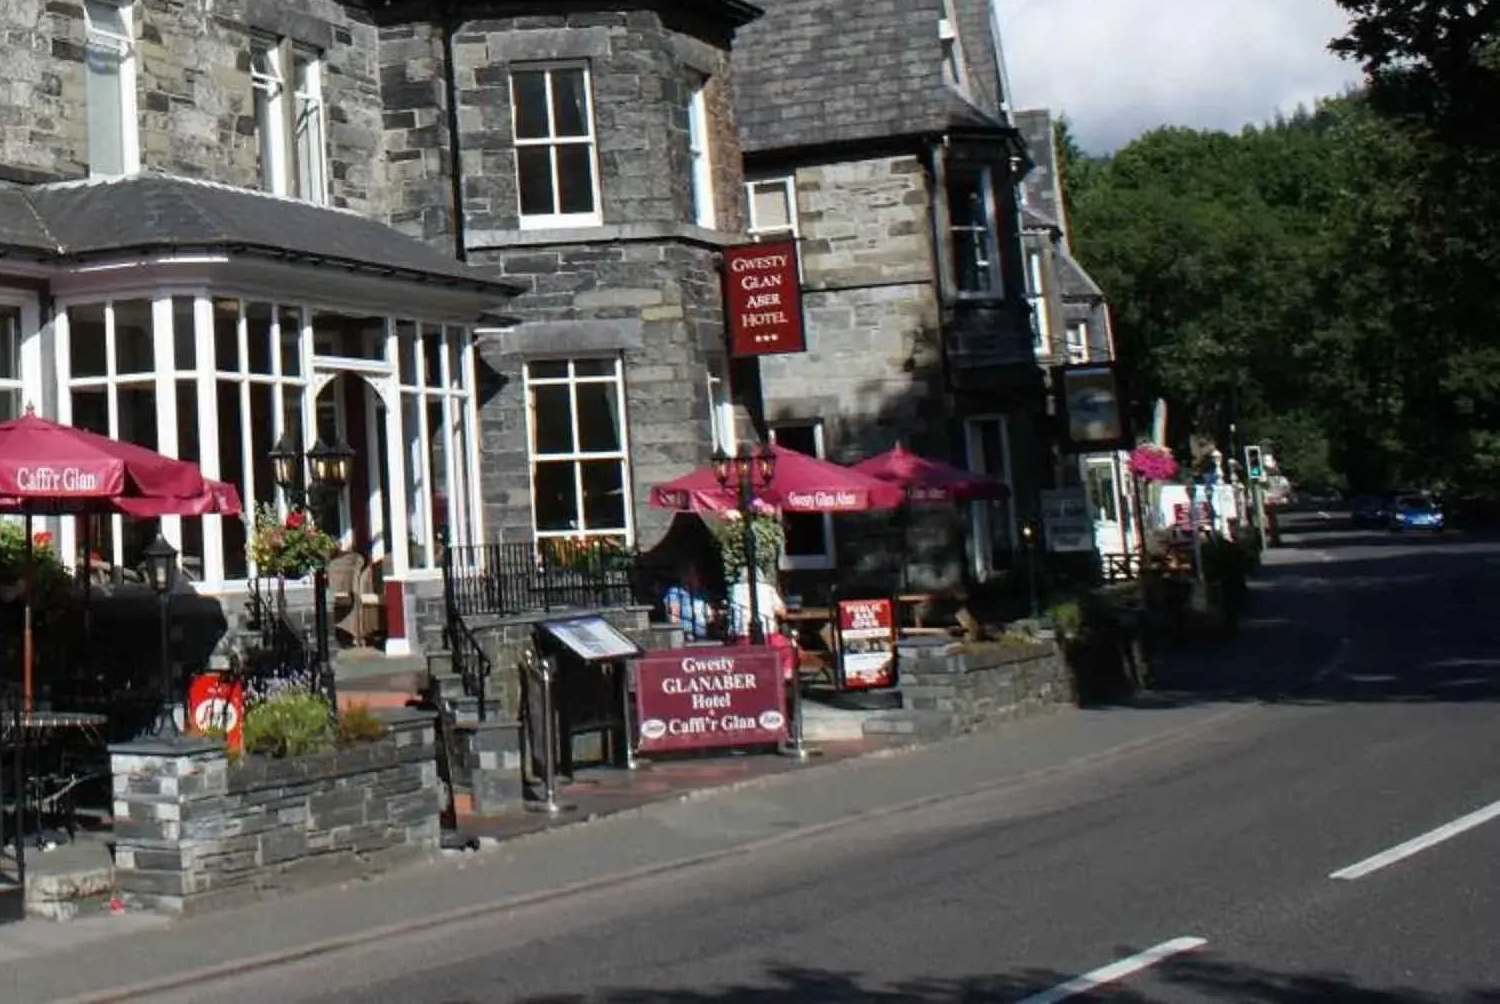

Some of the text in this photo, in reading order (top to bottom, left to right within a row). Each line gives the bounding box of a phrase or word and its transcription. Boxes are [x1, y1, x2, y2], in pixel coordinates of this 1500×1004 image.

[731, 254, 788, 273] GWESTY
[741, 273, 782, 291] GLAN
[746, 293, 781, 309] ABER
[741, 311, 789, 328] HOTEL
[63, 466, 97, 491] Glan
[681, 656, 735, 674] Gwesty
[661, 673, 757, 695] GLANABER
[691, 693, 732, 710] Hotel
[720, 713, 757, 731] Glan
